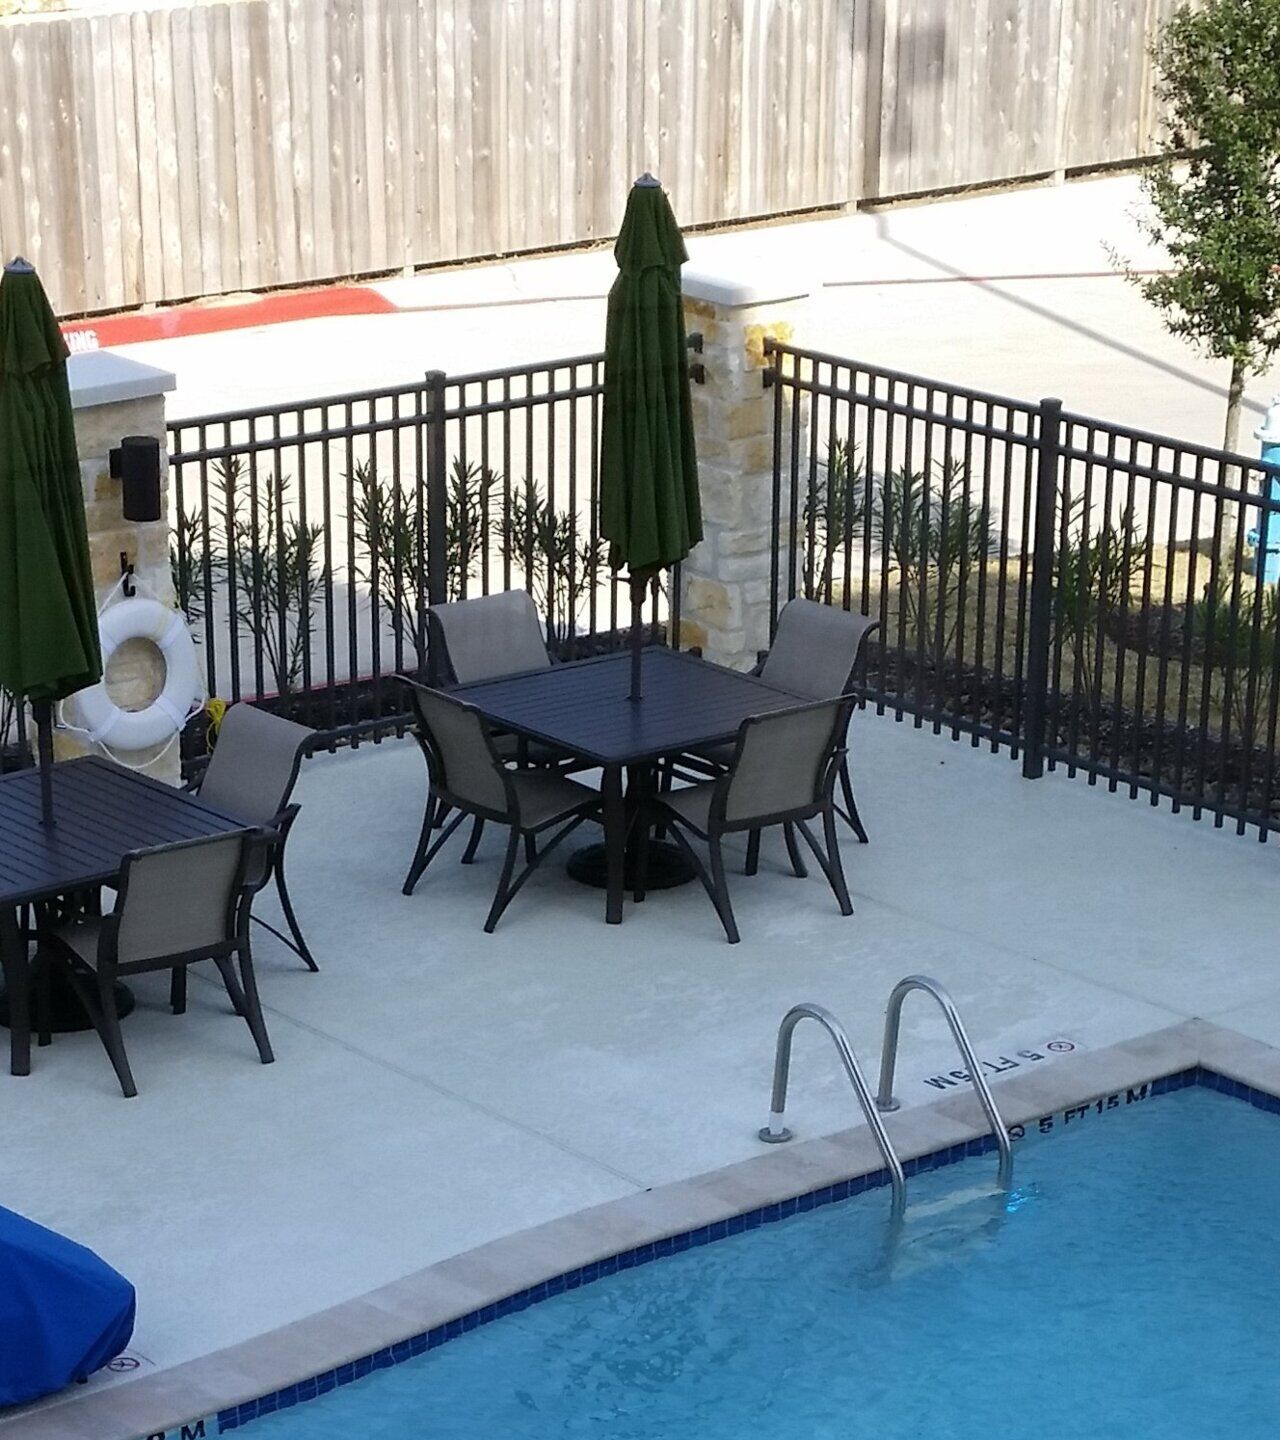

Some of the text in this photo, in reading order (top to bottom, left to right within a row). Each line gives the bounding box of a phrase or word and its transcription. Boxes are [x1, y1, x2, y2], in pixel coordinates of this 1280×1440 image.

[1017, 1050, 1045, 1061] 5
[982, 1057, 1020, 1073] FT
[1039, 1115, 1054, 1134] 5
[1064, 1103, 1090, 1125] FT
[1126, 1084, 1148, 1105] M
